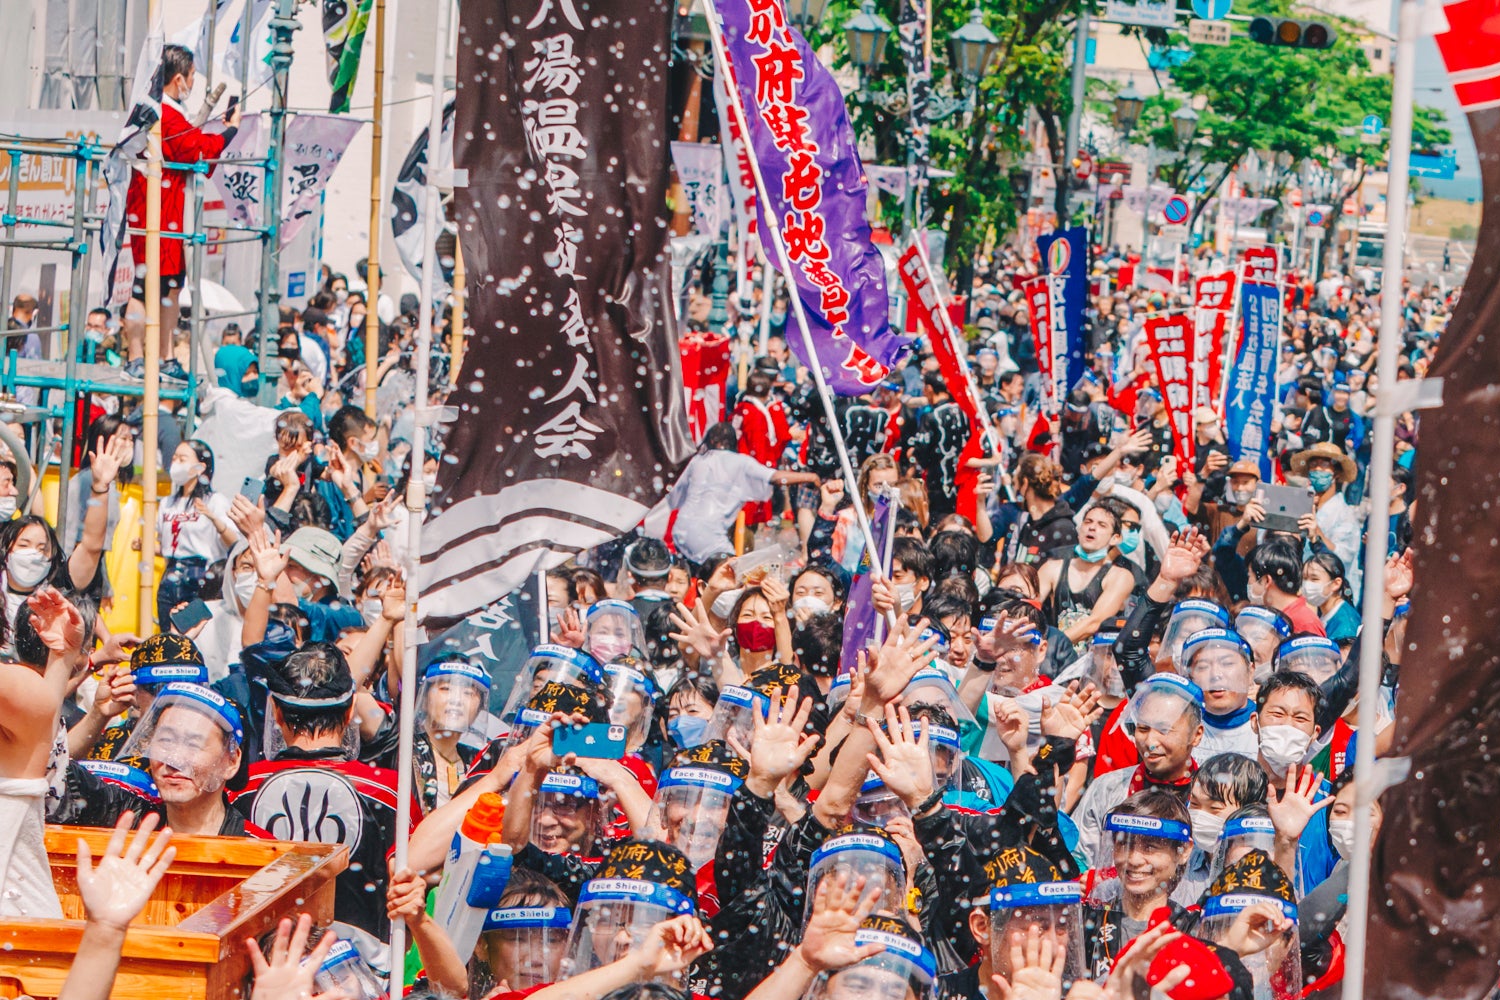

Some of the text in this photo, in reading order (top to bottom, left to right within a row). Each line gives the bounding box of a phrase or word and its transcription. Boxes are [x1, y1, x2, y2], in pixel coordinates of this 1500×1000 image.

[175, 667, 198, 675] Shield
[193, 686, 220, 703] Shield
[99, 763, 125, 774] Shield
[549, 776, 577, 785] Shield
[674, 770, 727, 783] Face Shield
[1113, 815, 1157, 827] Face Shield
[825, 837, 880, 850] Face Shield
[591, 882, 648, 891] Face Shield
[1044, 885, 1065, 893] Face
[495, 910, 550, 919] Face Shield
[884, 934, 916, 952] Shield
